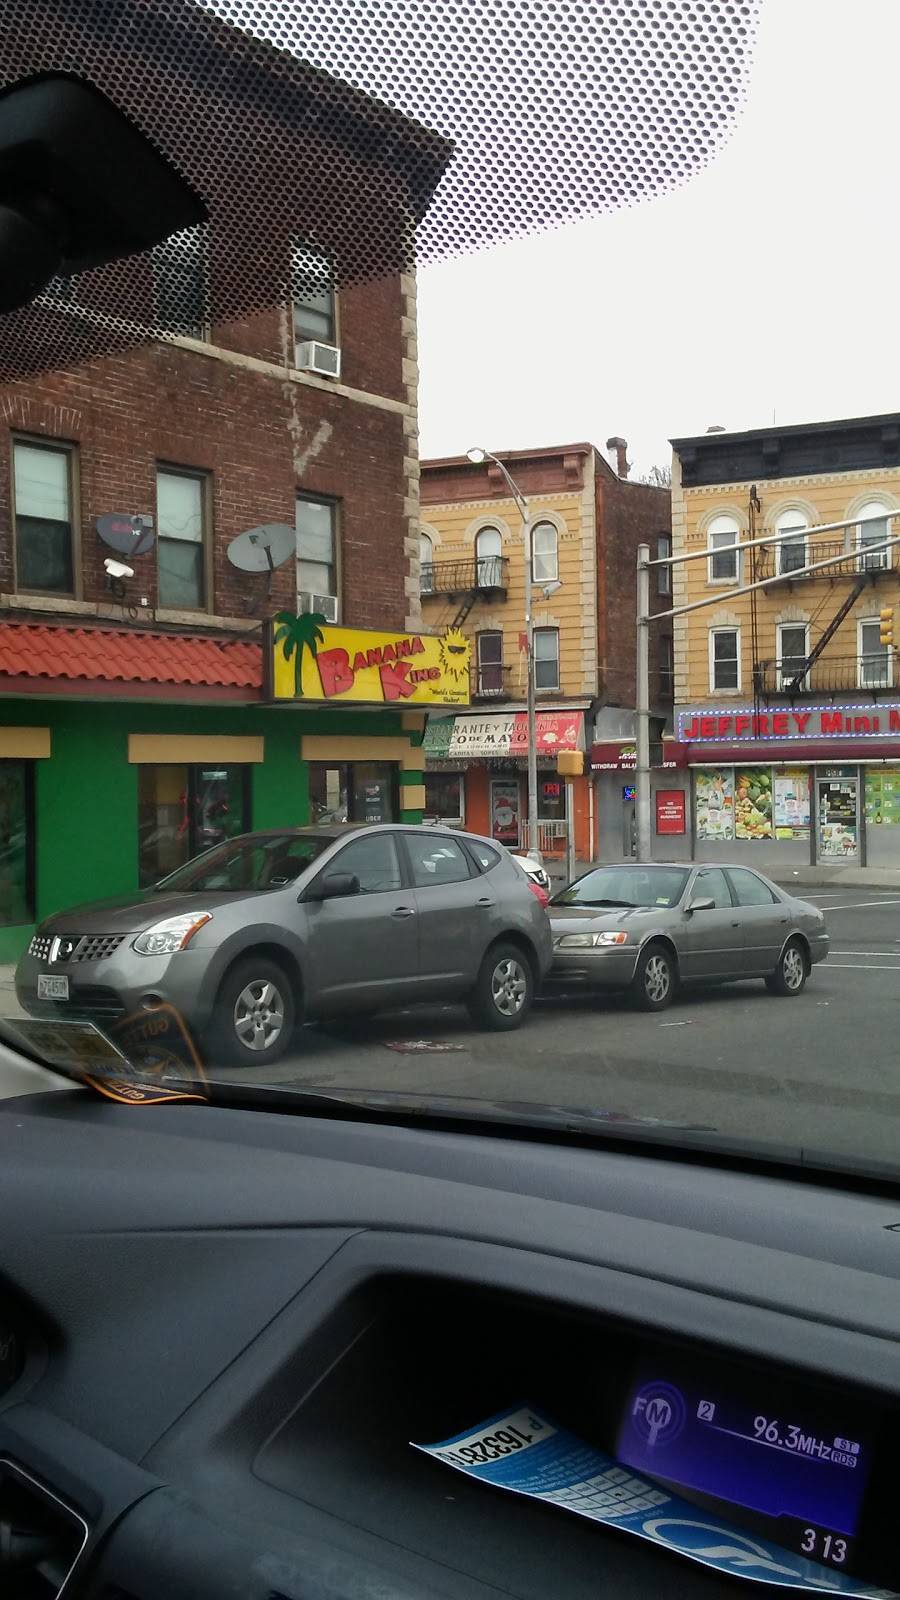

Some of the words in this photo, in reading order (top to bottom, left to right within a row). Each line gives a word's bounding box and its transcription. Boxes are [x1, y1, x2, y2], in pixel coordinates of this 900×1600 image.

[317, 637, 426, 698] BANANA
[379, 661, 442, 702] KING
[484, 734, 527, 744] MAYO
[684, 712, 812, 739] JEFFREY
[820, 711, 880, 734] Mini
[632, 1396, 670, 1424] FM
[699, 1402, 713, 1420] 2
[832, 1451, 857, 1468] RDS
